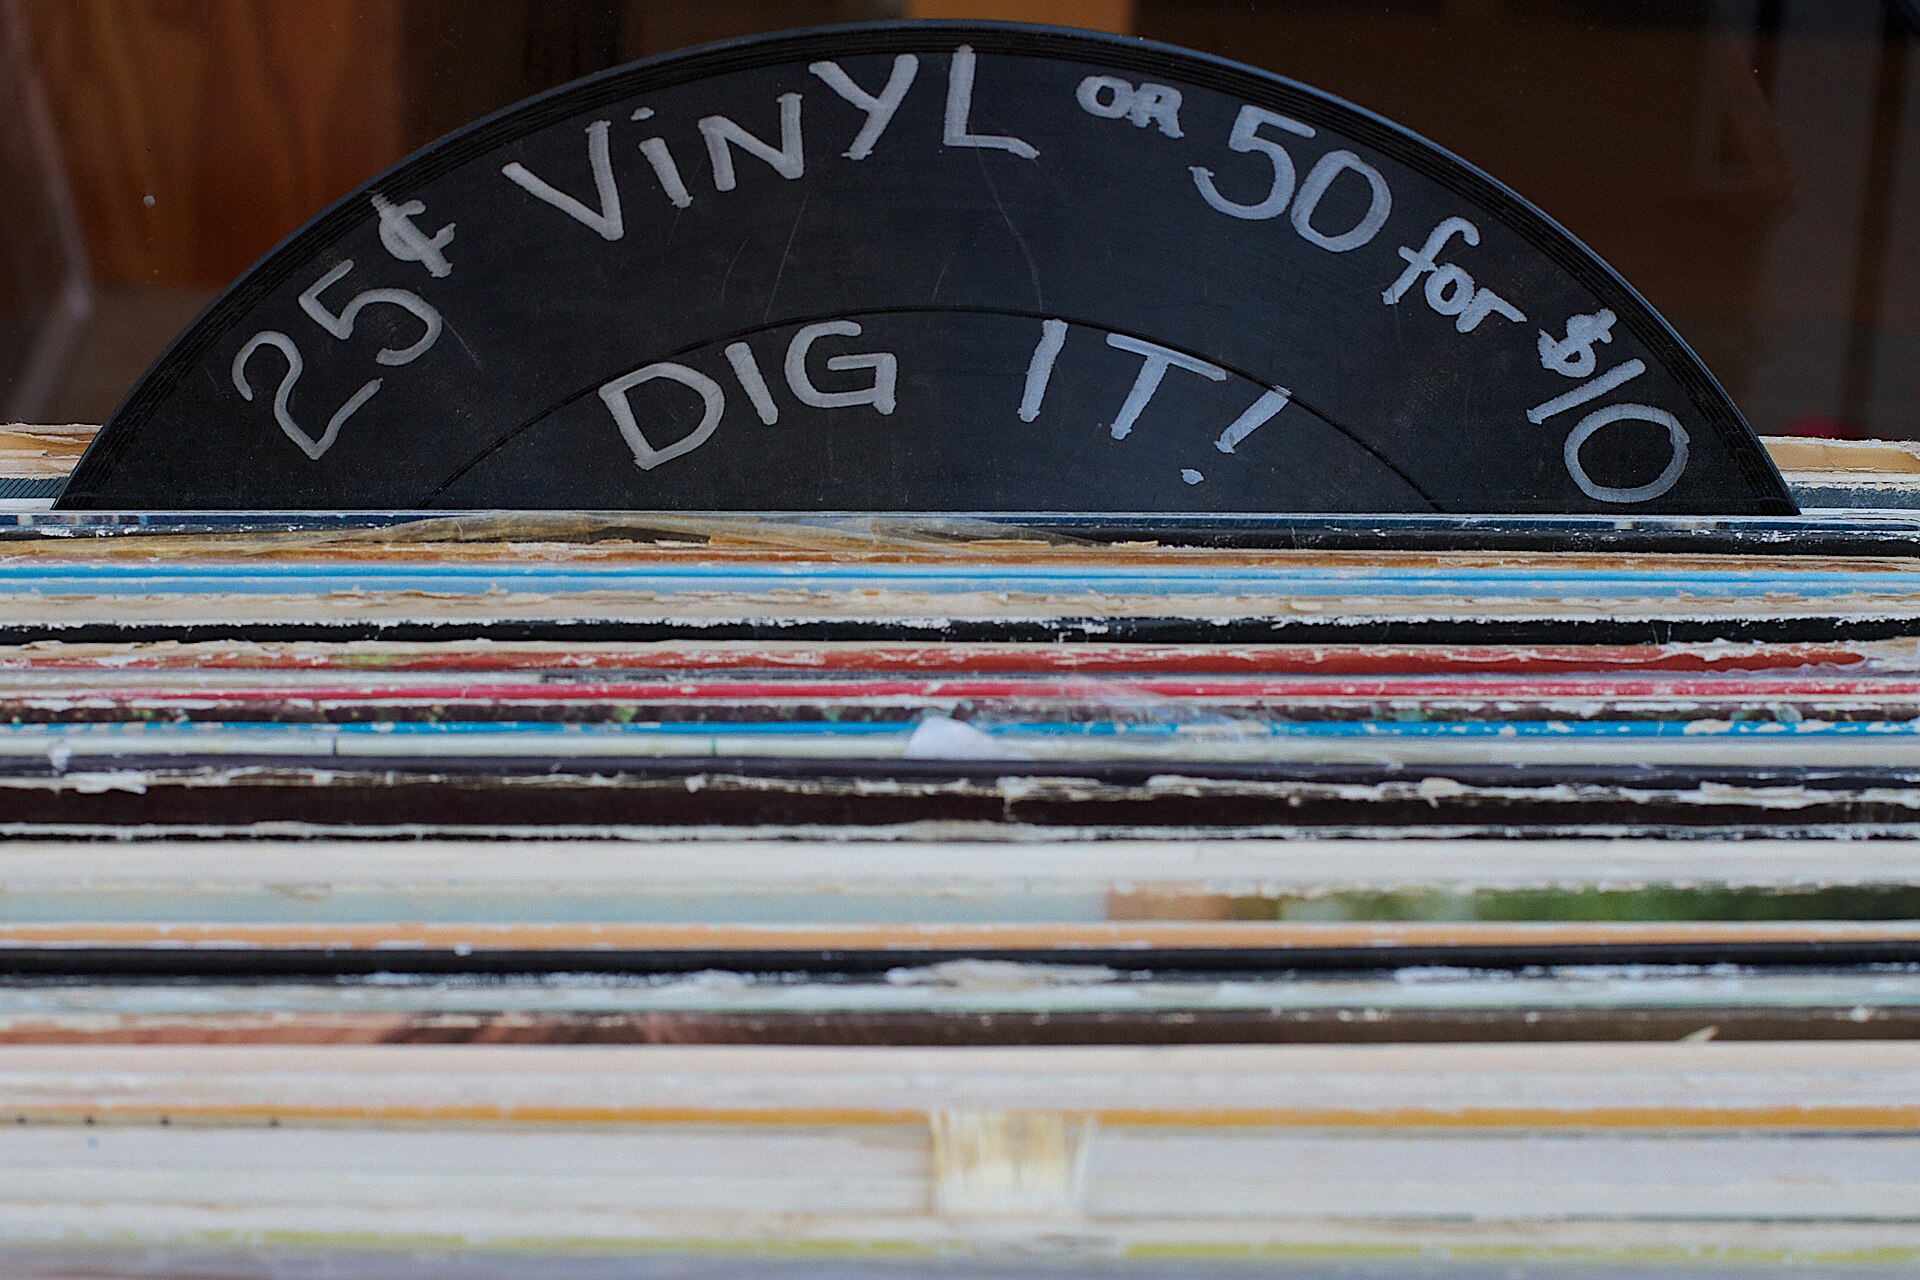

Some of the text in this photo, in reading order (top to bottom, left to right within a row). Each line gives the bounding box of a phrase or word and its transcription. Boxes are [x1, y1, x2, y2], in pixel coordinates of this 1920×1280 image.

[597, 318, 1291, 486] DIG IT!
[1189, 104, 1393, 254] 50
[1380, 215, 1527, 334] for
[1526, 307, 1690, 504] $10
